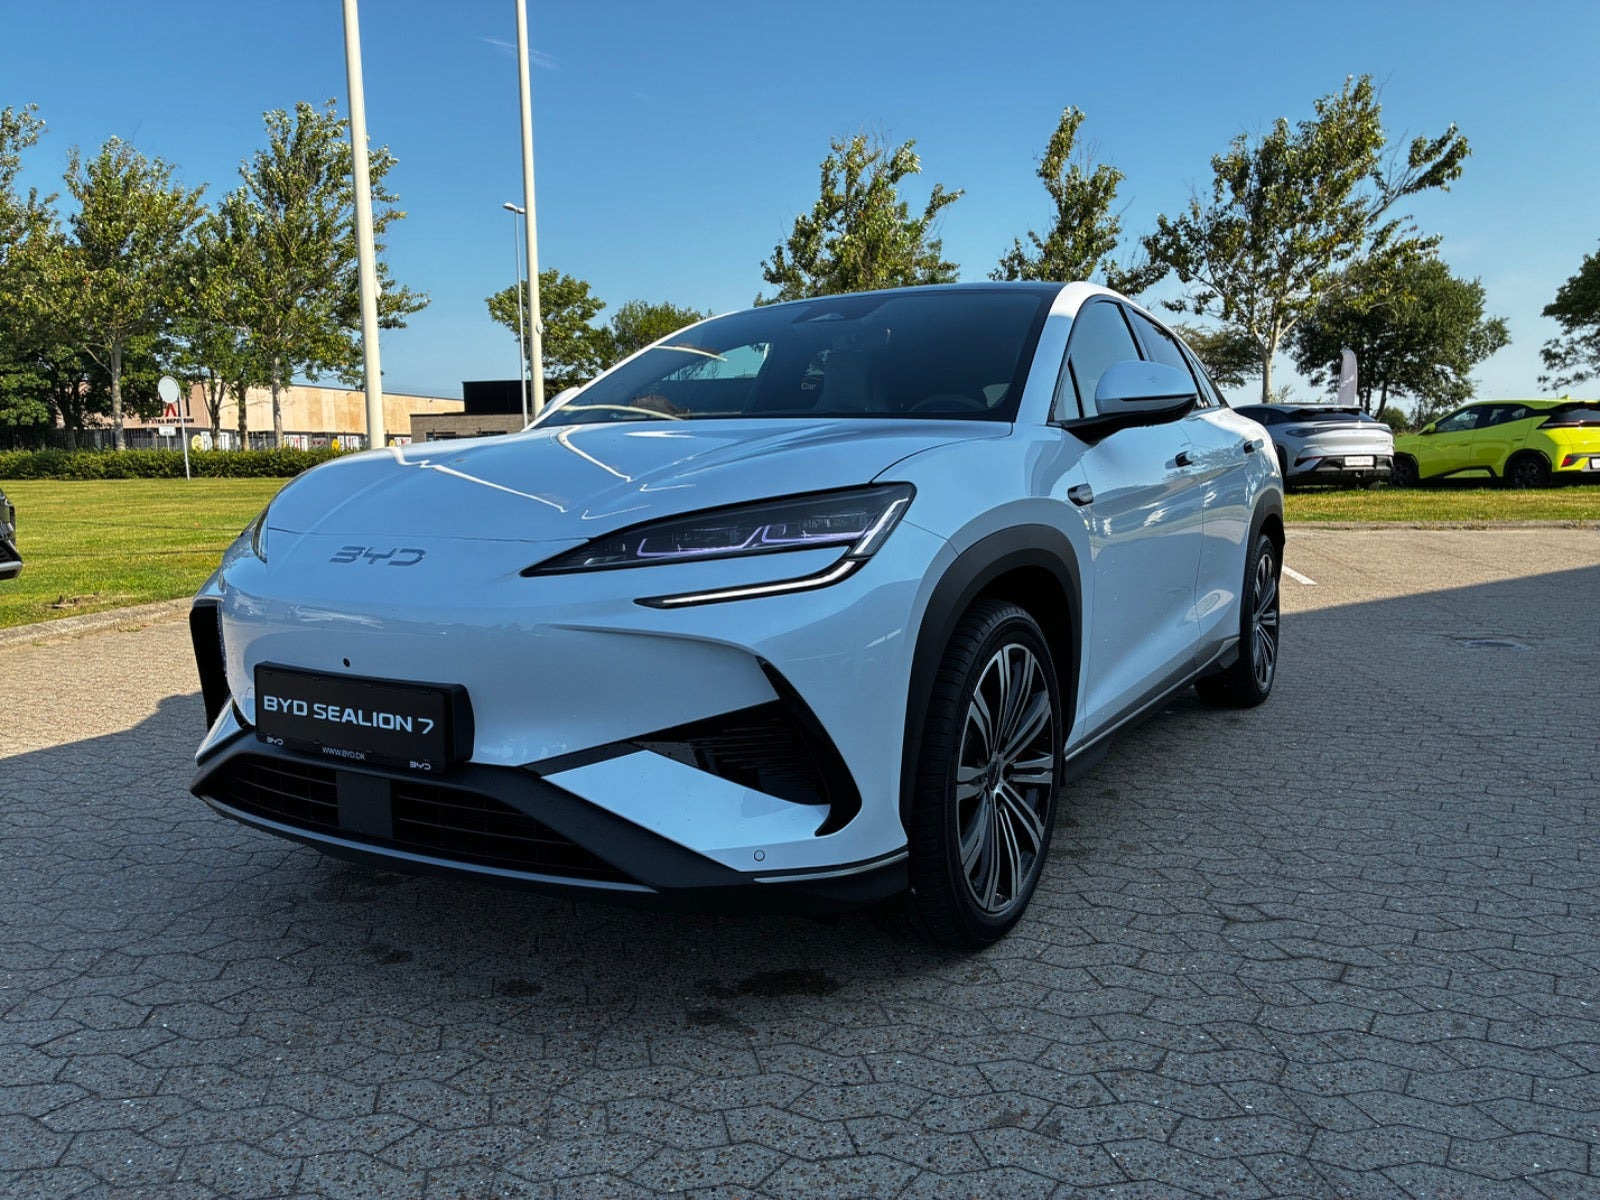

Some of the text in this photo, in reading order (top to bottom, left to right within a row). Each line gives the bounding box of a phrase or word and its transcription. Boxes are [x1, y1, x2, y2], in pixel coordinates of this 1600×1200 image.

[329, 545, 426, 567] BYD
[263, 695, 434, 734] BYD SEALION 7
[409, 760, 431, 770] BYD
